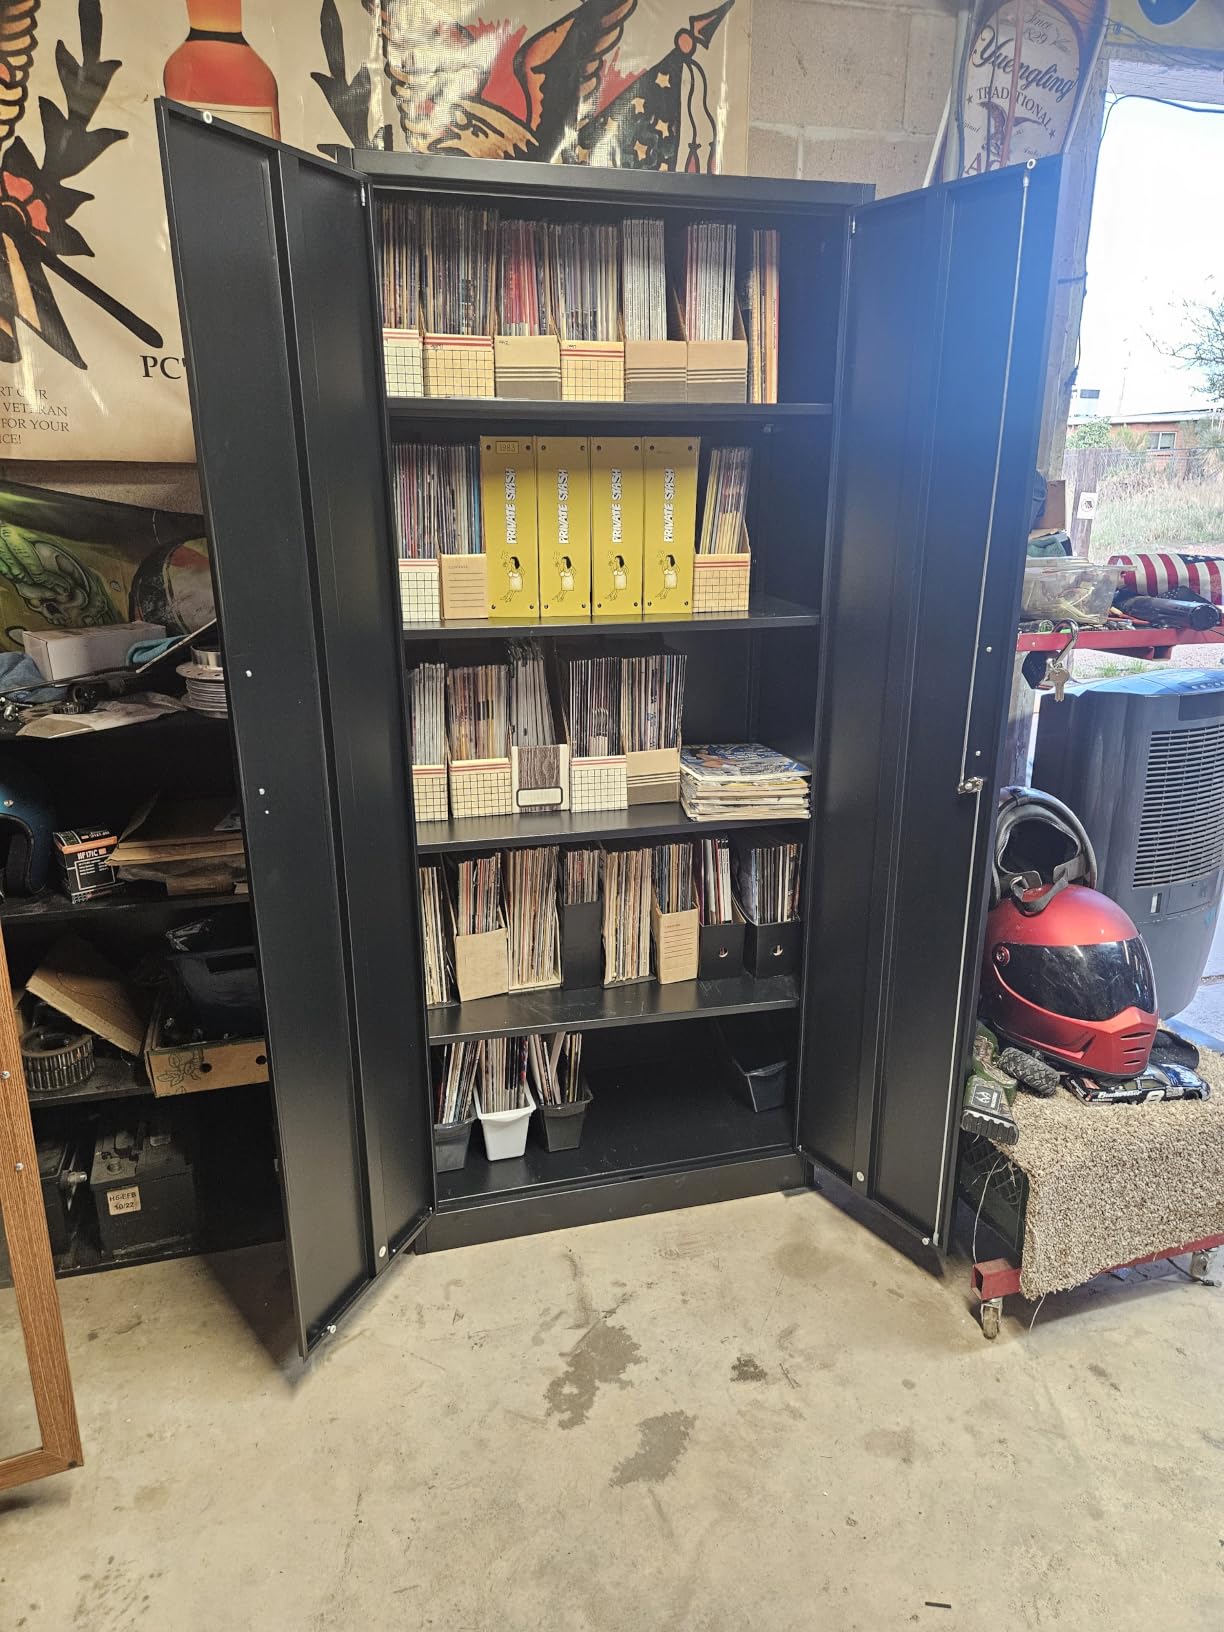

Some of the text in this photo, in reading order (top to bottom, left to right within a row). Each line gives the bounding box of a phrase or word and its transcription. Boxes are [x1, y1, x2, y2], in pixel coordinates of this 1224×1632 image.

[971, 25, 1078, 103] Yuengling
[977, 86, 1051, 130] TRADTIONAL
[1, 418, 70, 432] FOR YOUR
[505, 468, 518, 544] PRIVATE STASH
[558, 468, 570, 544] PRIVATE STASH
[611, 468, 623, 543] PRIVATE STASH
[663, 468, 675, 542] PRIVATE STASH
[114, 1202, 134, 1210] 10/22
